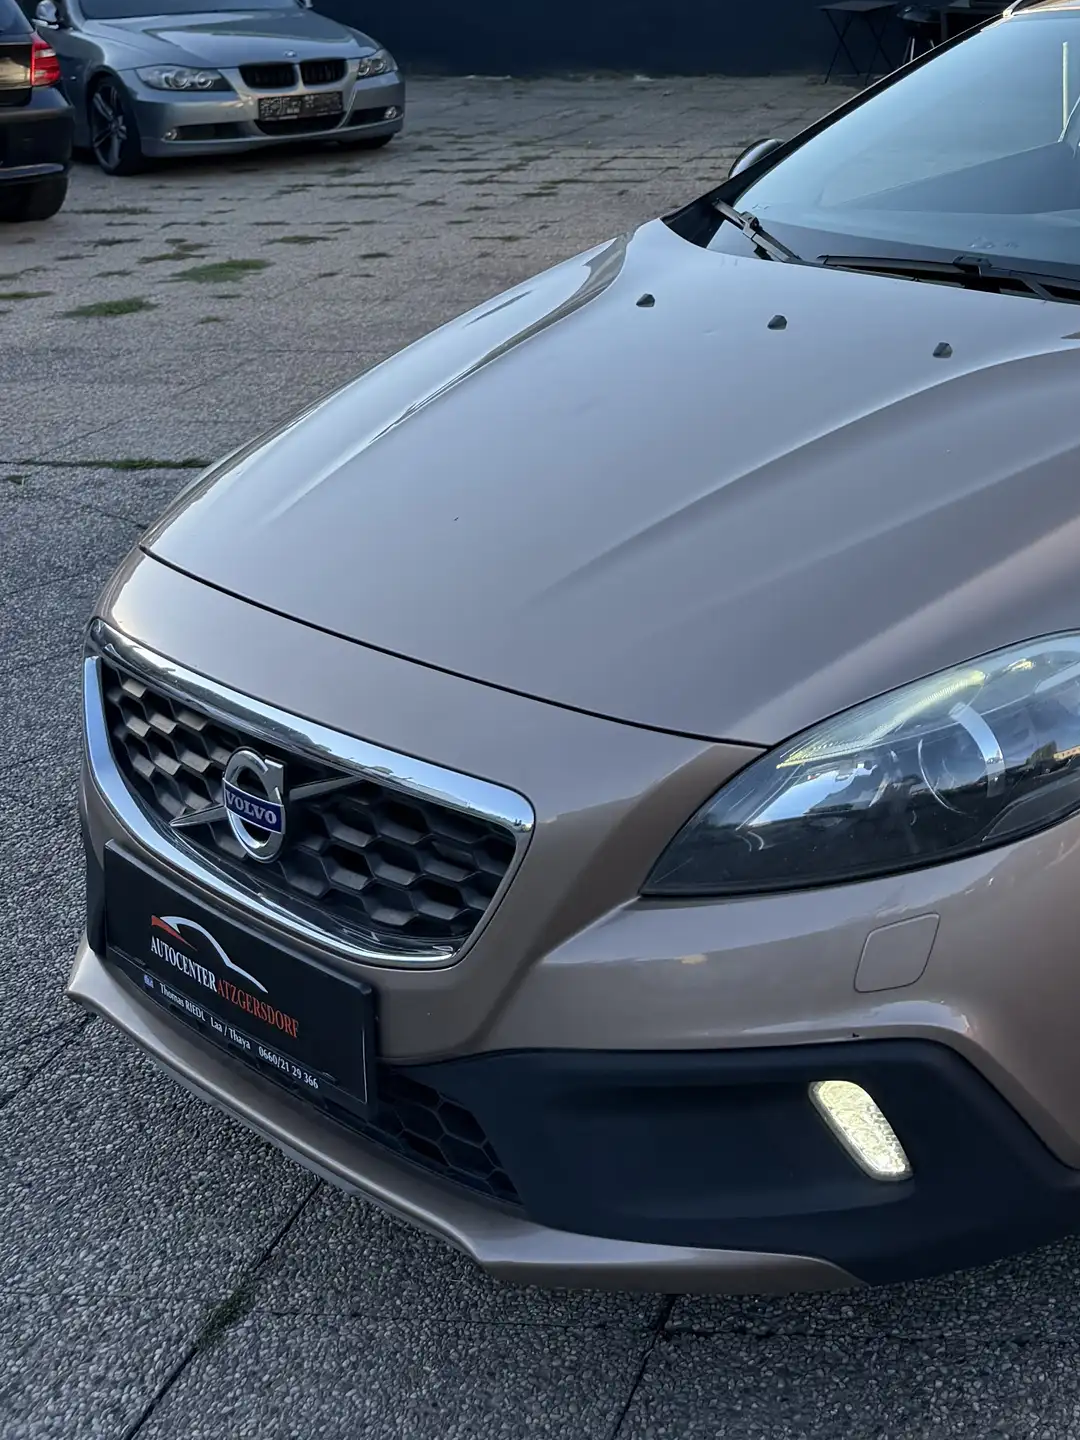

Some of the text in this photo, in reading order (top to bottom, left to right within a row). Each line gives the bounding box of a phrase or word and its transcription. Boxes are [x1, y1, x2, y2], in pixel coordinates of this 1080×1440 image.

[224, 788, 277, 825] VOLVO
[150, 935, 299, 1039] AUTOCENTER ATZGERSDORF
[160, 982, 185, 1007] Thomas
[185, 999, 206, 1022] RIEDL
[210, 1016, 223, 1033] Laa
[228, 1027, 251, 1050] Thaya
[258, 1046, 289, 1072] 0660/21
[291, 1065, 302, 1079] 29
[303, 1072, 319, 1089] 366
